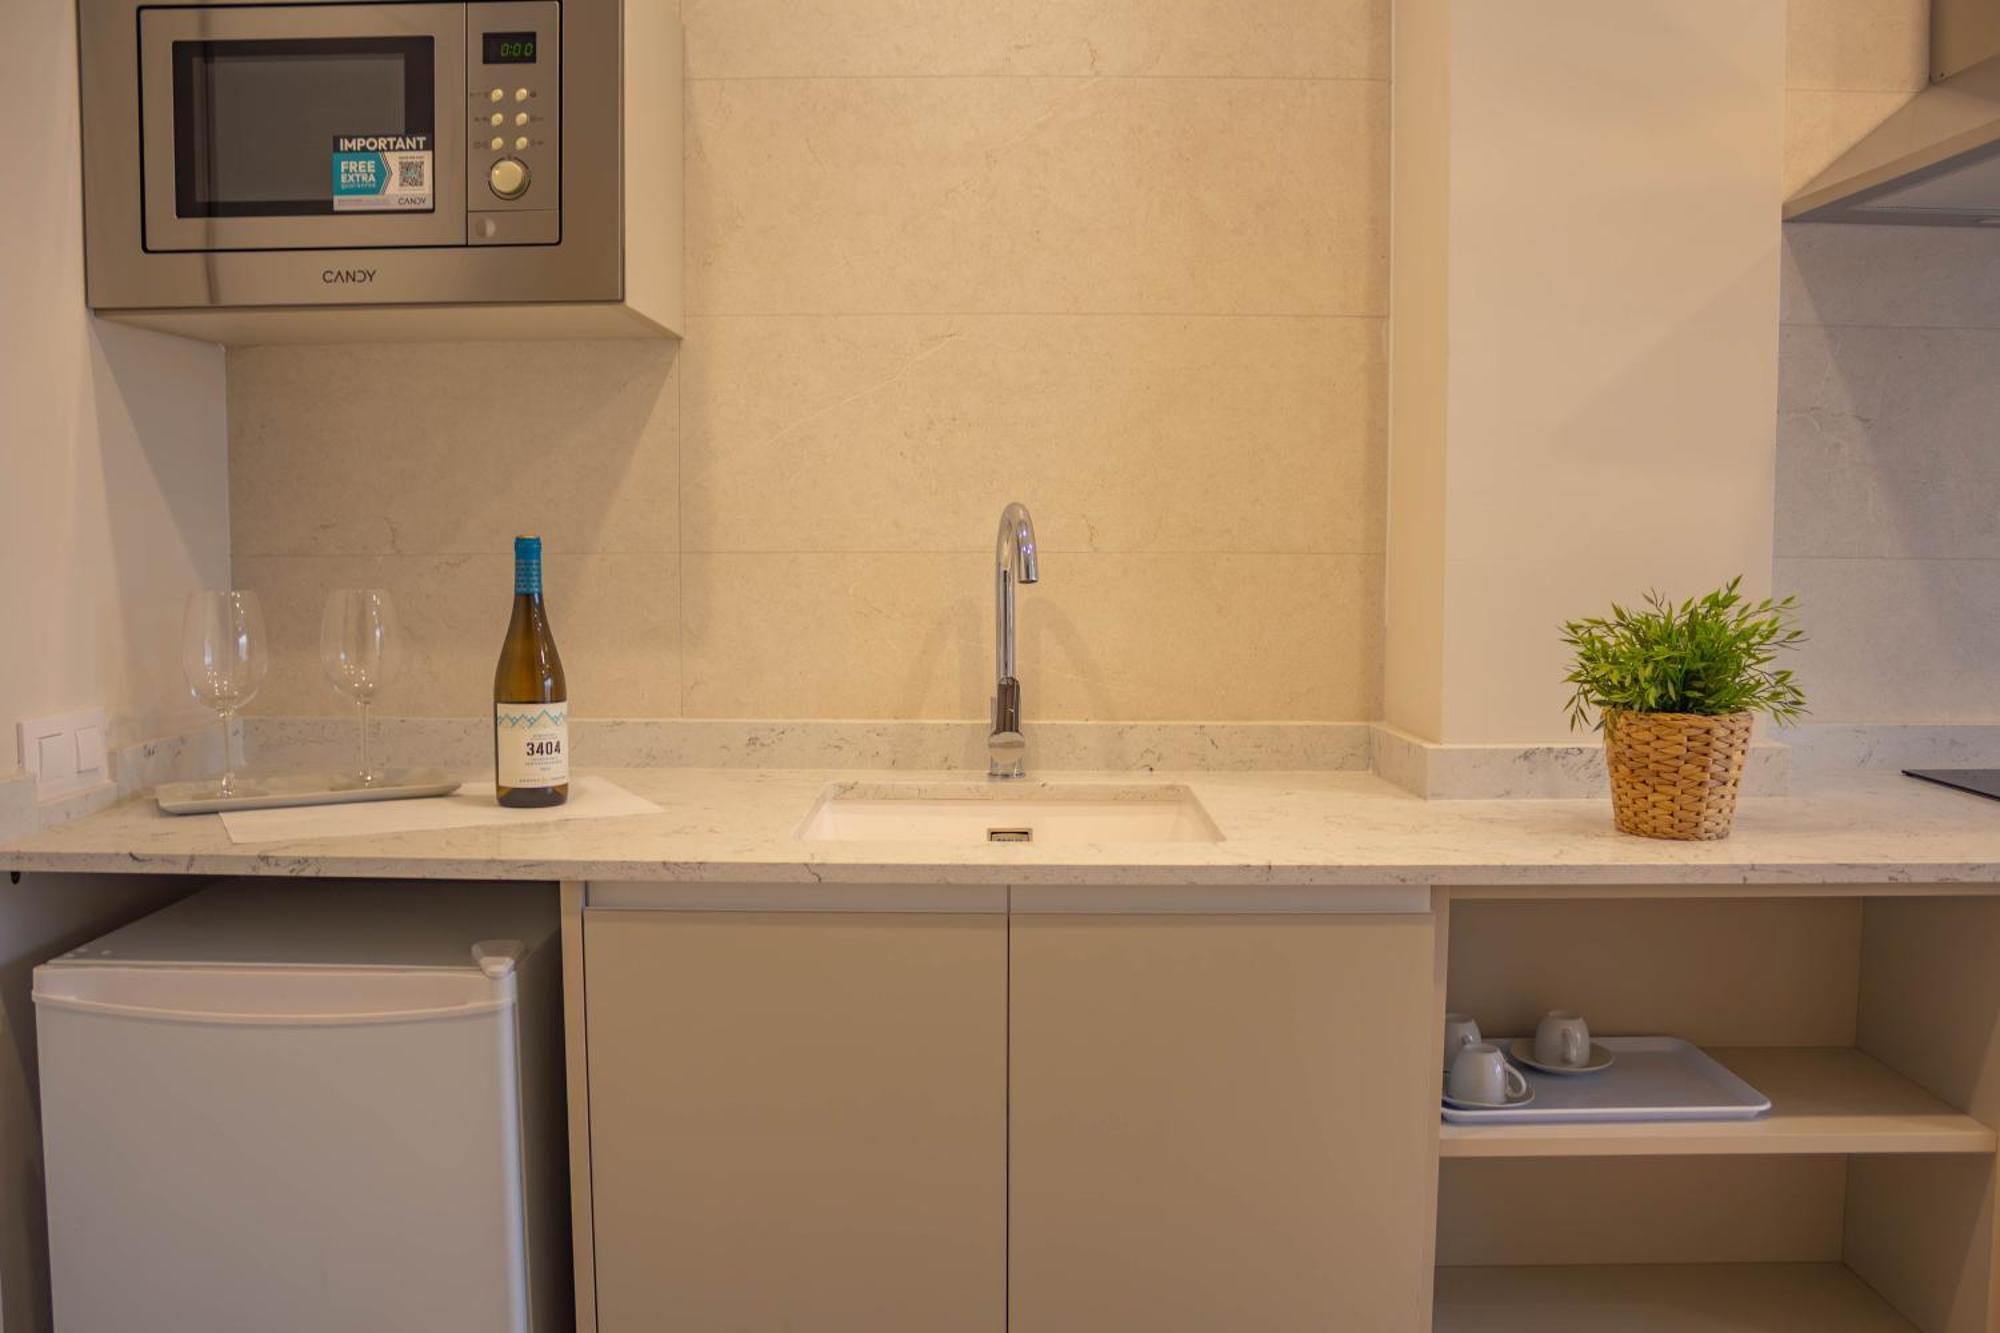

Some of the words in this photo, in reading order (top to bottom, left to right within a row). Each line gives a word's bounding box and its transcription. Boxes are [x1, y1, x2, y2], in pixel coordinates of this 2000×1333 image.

[501, 42, 533, 57] 0:00
[340, 136, 426, 151] IMPORTANT
[341, 160, 376, 173] FREE
[341, 173, 376, 183] EXTRA
[398, 197, 426, 206] CANDY
[322, 269, 376, 284] CANDY
[526, 740, 561, 756] 3404
